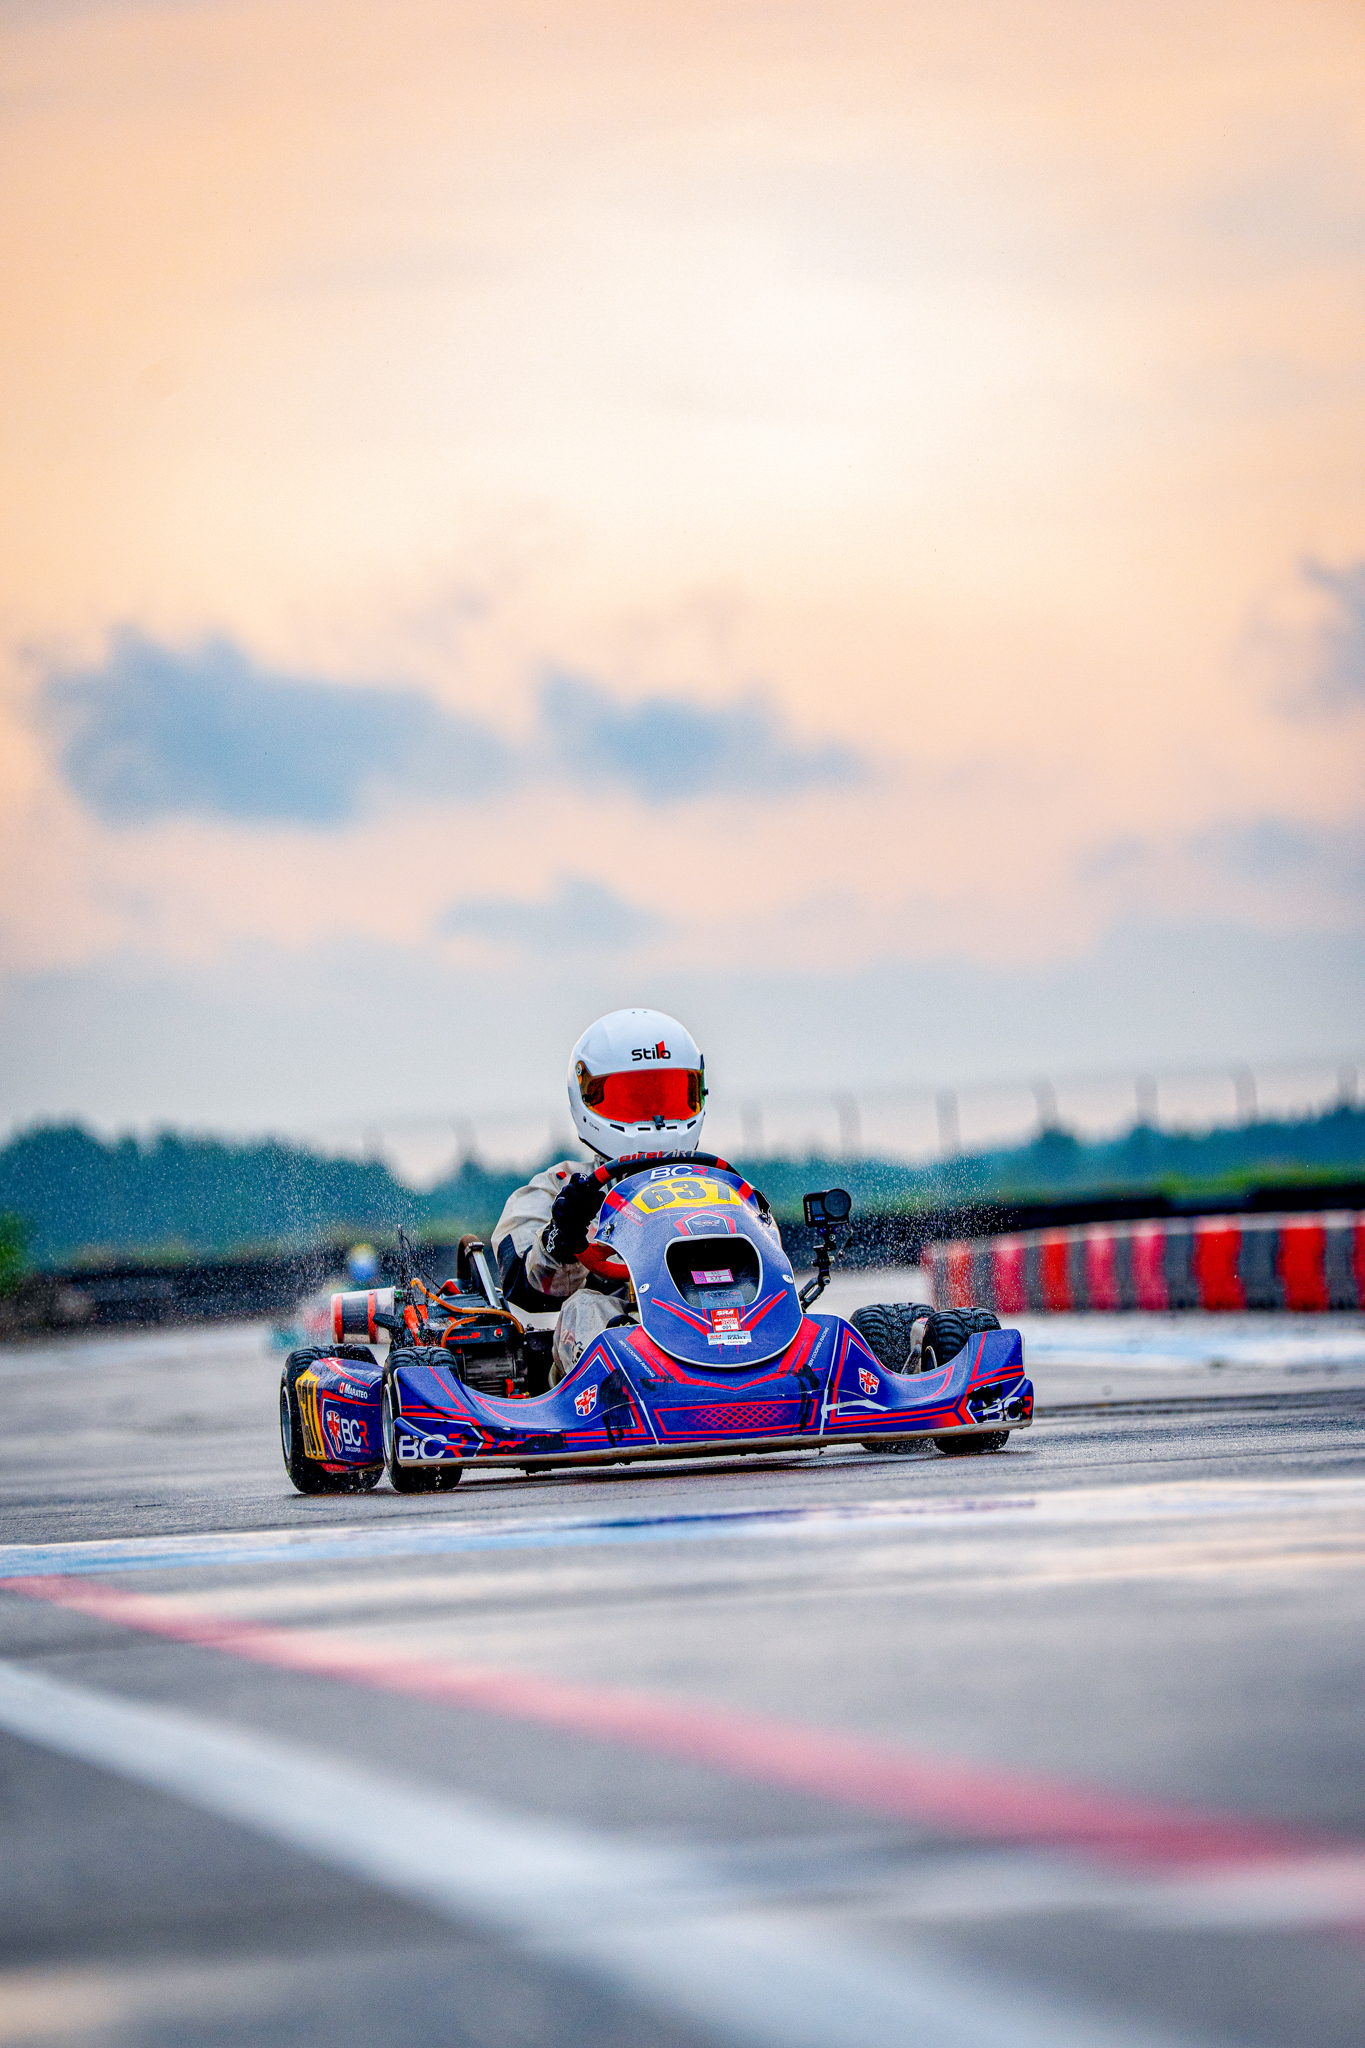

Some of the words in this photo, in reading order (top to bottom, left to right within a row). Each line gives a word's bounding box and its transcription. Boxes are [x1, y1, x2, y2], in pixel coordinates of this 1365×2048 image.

[631, 1043, 671, 1062] Stilo
[650, 1165, 709, 1180] BCR
[640, 1180, 731, 1210] 637
[344, 1383, 368, 1400] MARATEO
[341, 1418, 369, 1447] BCR
[399, 1433, 468, 1460] BCR
